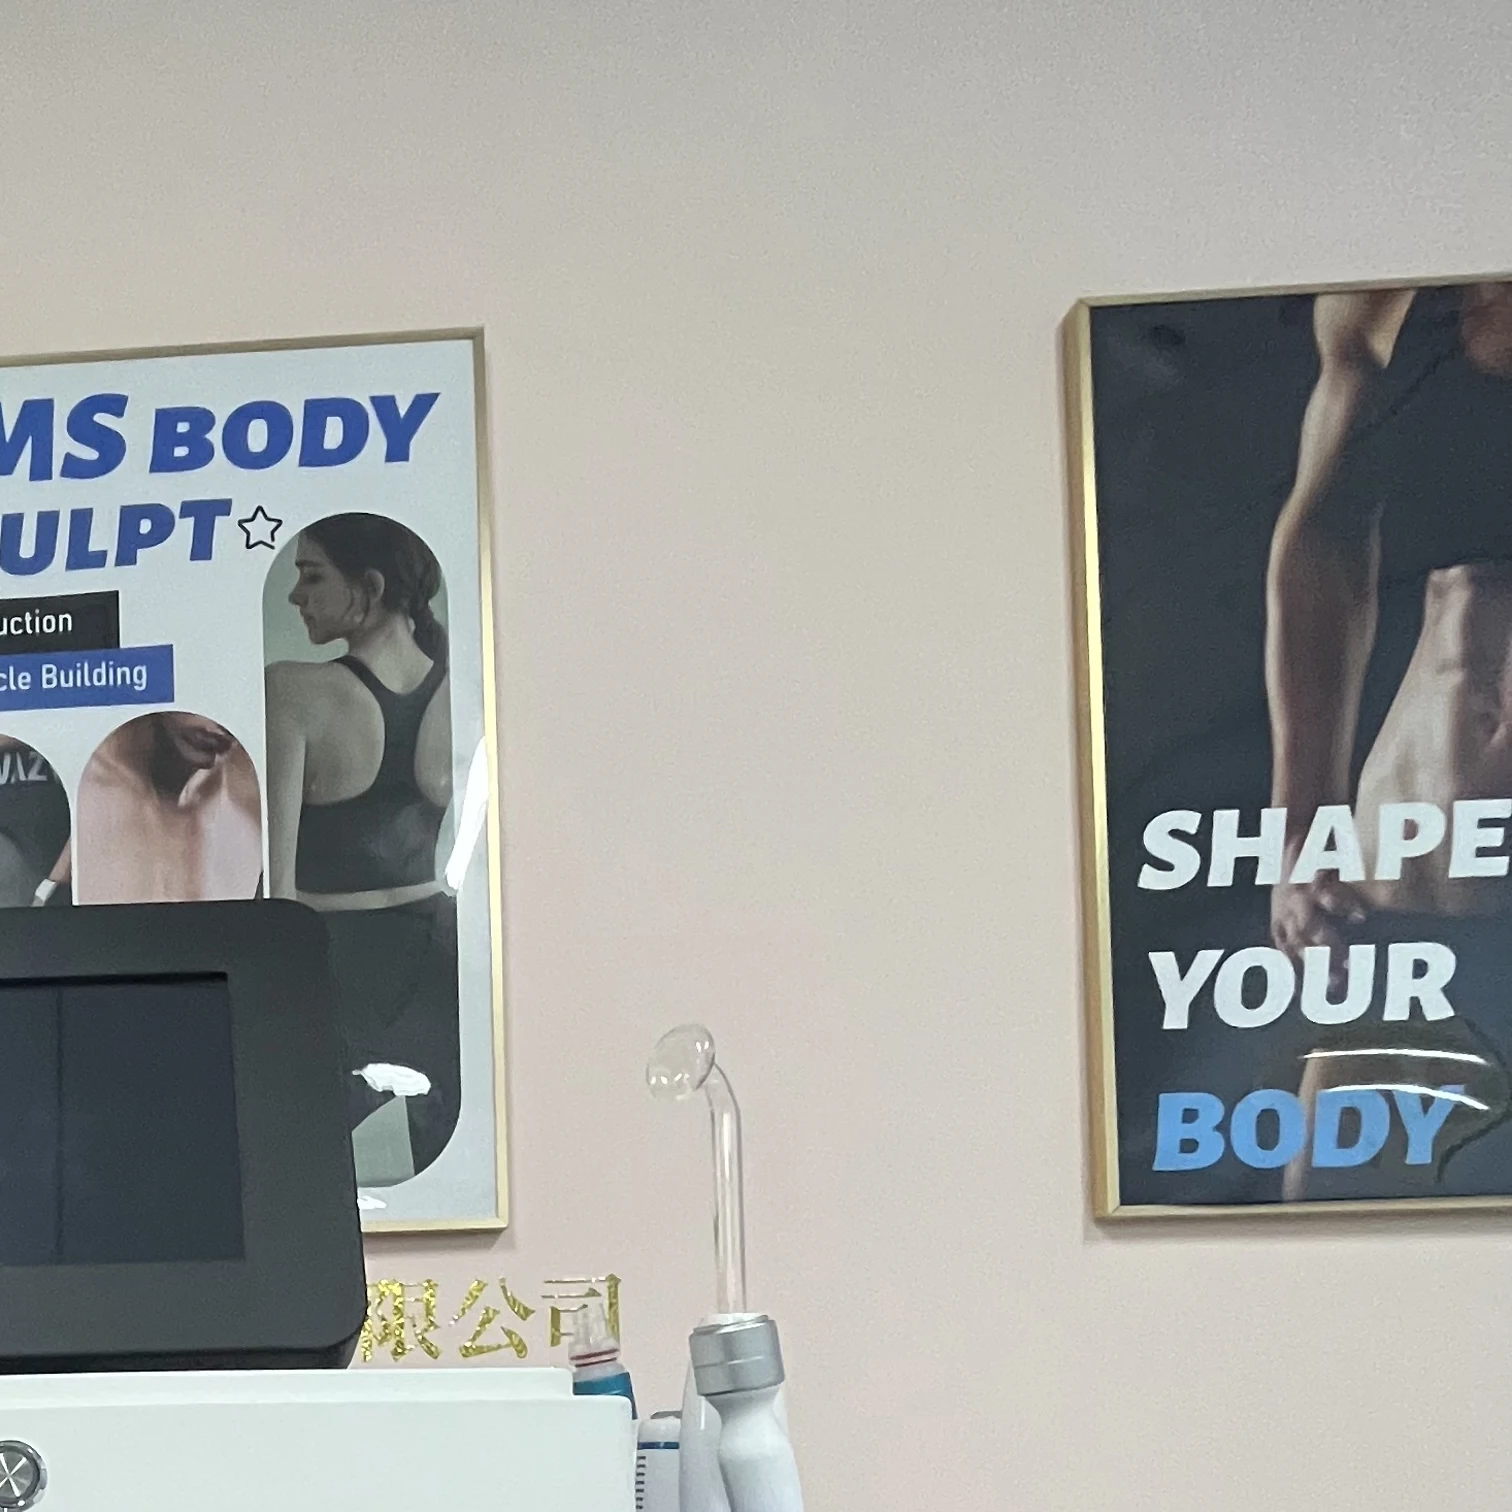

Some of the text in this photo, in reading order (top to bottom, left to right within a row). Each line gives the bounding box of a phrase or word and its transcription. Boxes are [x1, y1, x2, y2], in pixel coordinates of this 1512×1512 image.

[148, 391, 441, 475] BODY
[40, 659, 149, 694] Building
[1136, 797, 1512, 891] SHAPE
[1148, 941, 1458, 1030] YOUR
[1152, 1083, 1467, 1172] BODY
